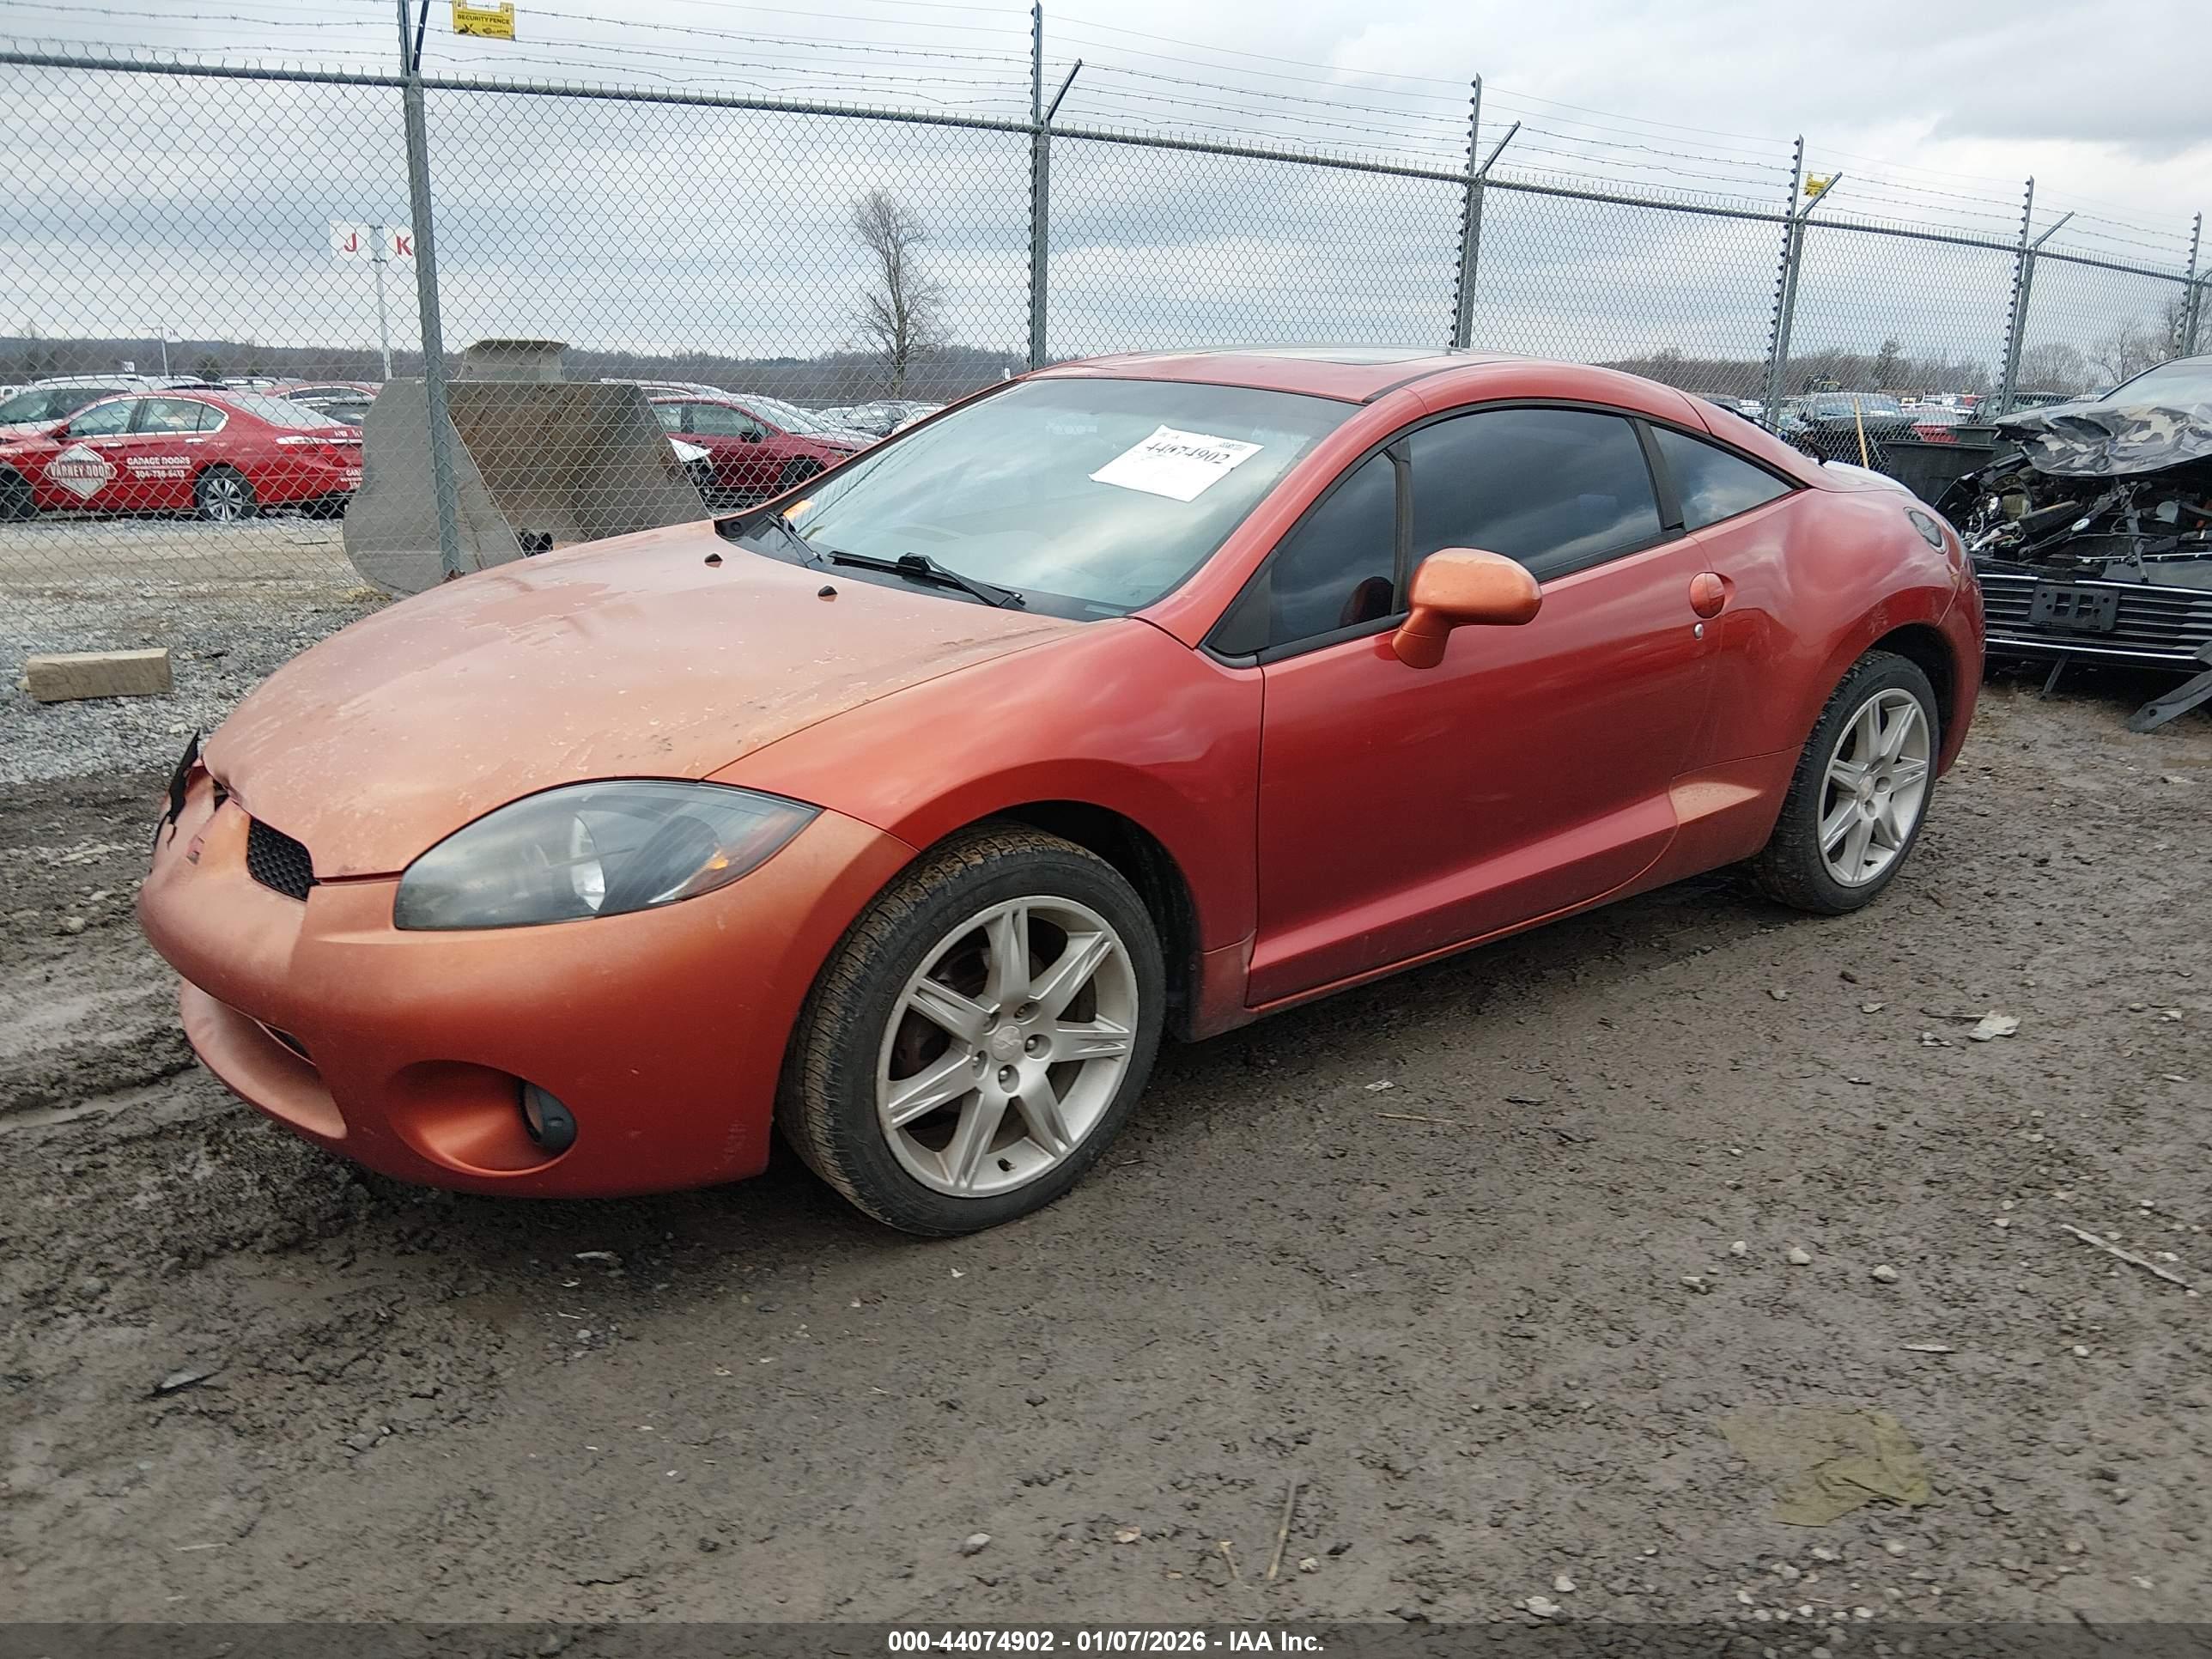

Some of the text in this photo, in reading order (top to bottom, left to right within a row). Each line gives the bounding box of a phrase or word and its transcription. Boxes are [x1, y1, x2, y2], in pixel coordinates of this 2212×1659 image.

[344, 233, 357, 252] J
[396, 235, 413, 256] K
[126, 456, 191, 465] GARAGE DOORS
[50, 465, 84, 477] VARNEY
[85, 465, 112, 478] DOOR
